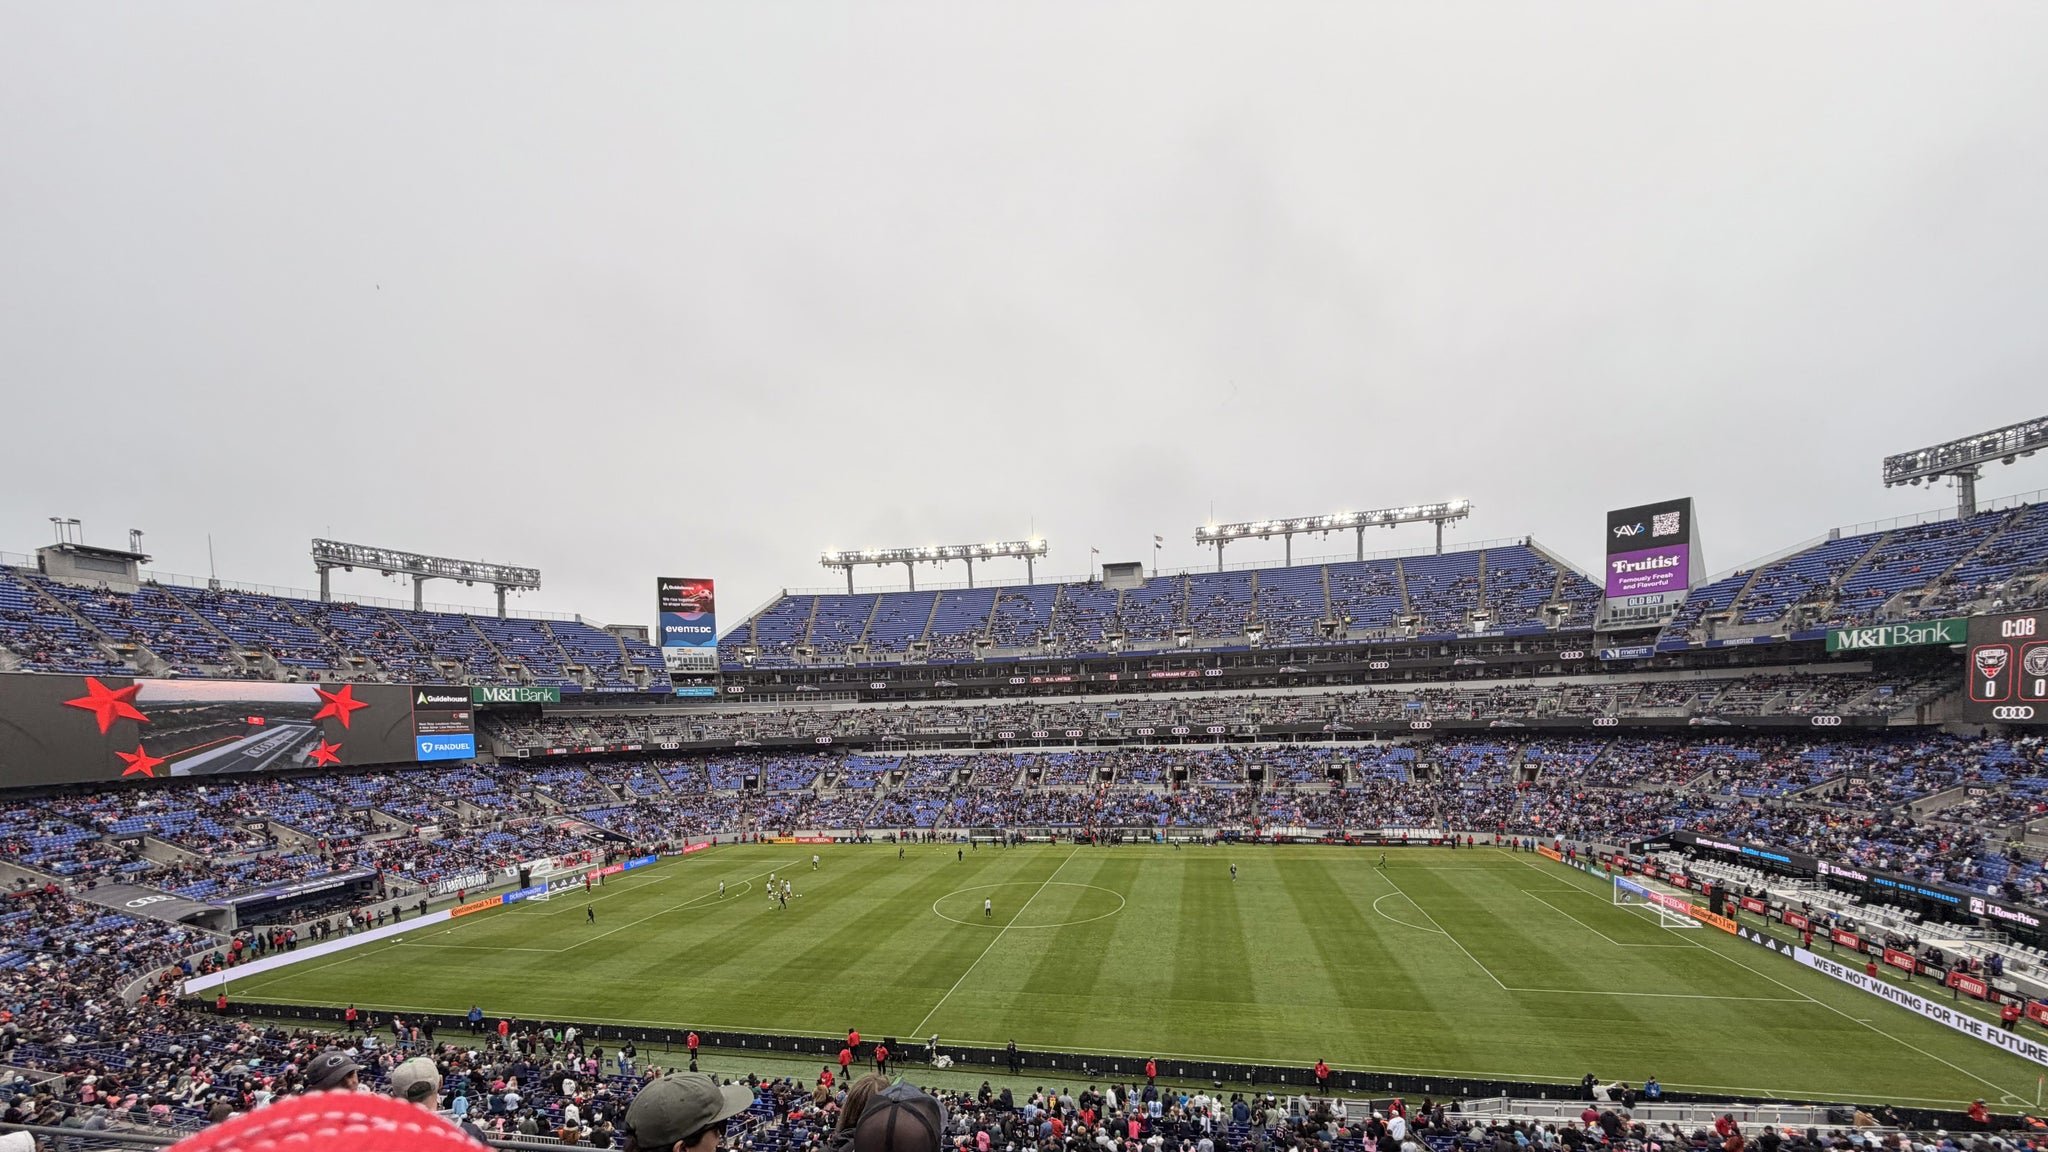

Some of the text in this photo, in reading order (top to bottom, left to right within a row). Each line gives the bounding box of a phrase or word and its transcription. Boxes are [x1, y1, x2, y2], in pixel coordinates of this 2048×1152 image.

[1612, 556, 1680, 574] Fruitist
[1619, 576, 1652, 584] Famously
[1637, 580, 1668, 588] Flavorful
[1629, 595, 1662, 606] OLD BAY
[2002, 618, 2036, 637] 0:08
[1837, 622, 1951, 650] M&T Bank
[482, 687, 553, 702] M&T Bank
[1985, 681, 1995, 697] 0
[2035, 679, 2045, 696] 0
[1696, 838, 1713, 846] Better
[1742, 846, 1760, 856] Better
[446, 876, 467, 893] BARRA
[466, 870, 488, 888] BRAVA
[1874, 878, 1896, 887] INVEST
[1898, 883, 1916, 892] WITH
[452, 901, 484, 916] Continental
[1722, 916, 1735, 930] Tire
[1960, 978, 1982, 994] UNITED
[1814, 957, 2048, 1064] WE'RE NOT WAITING FOR THE FUTURE
